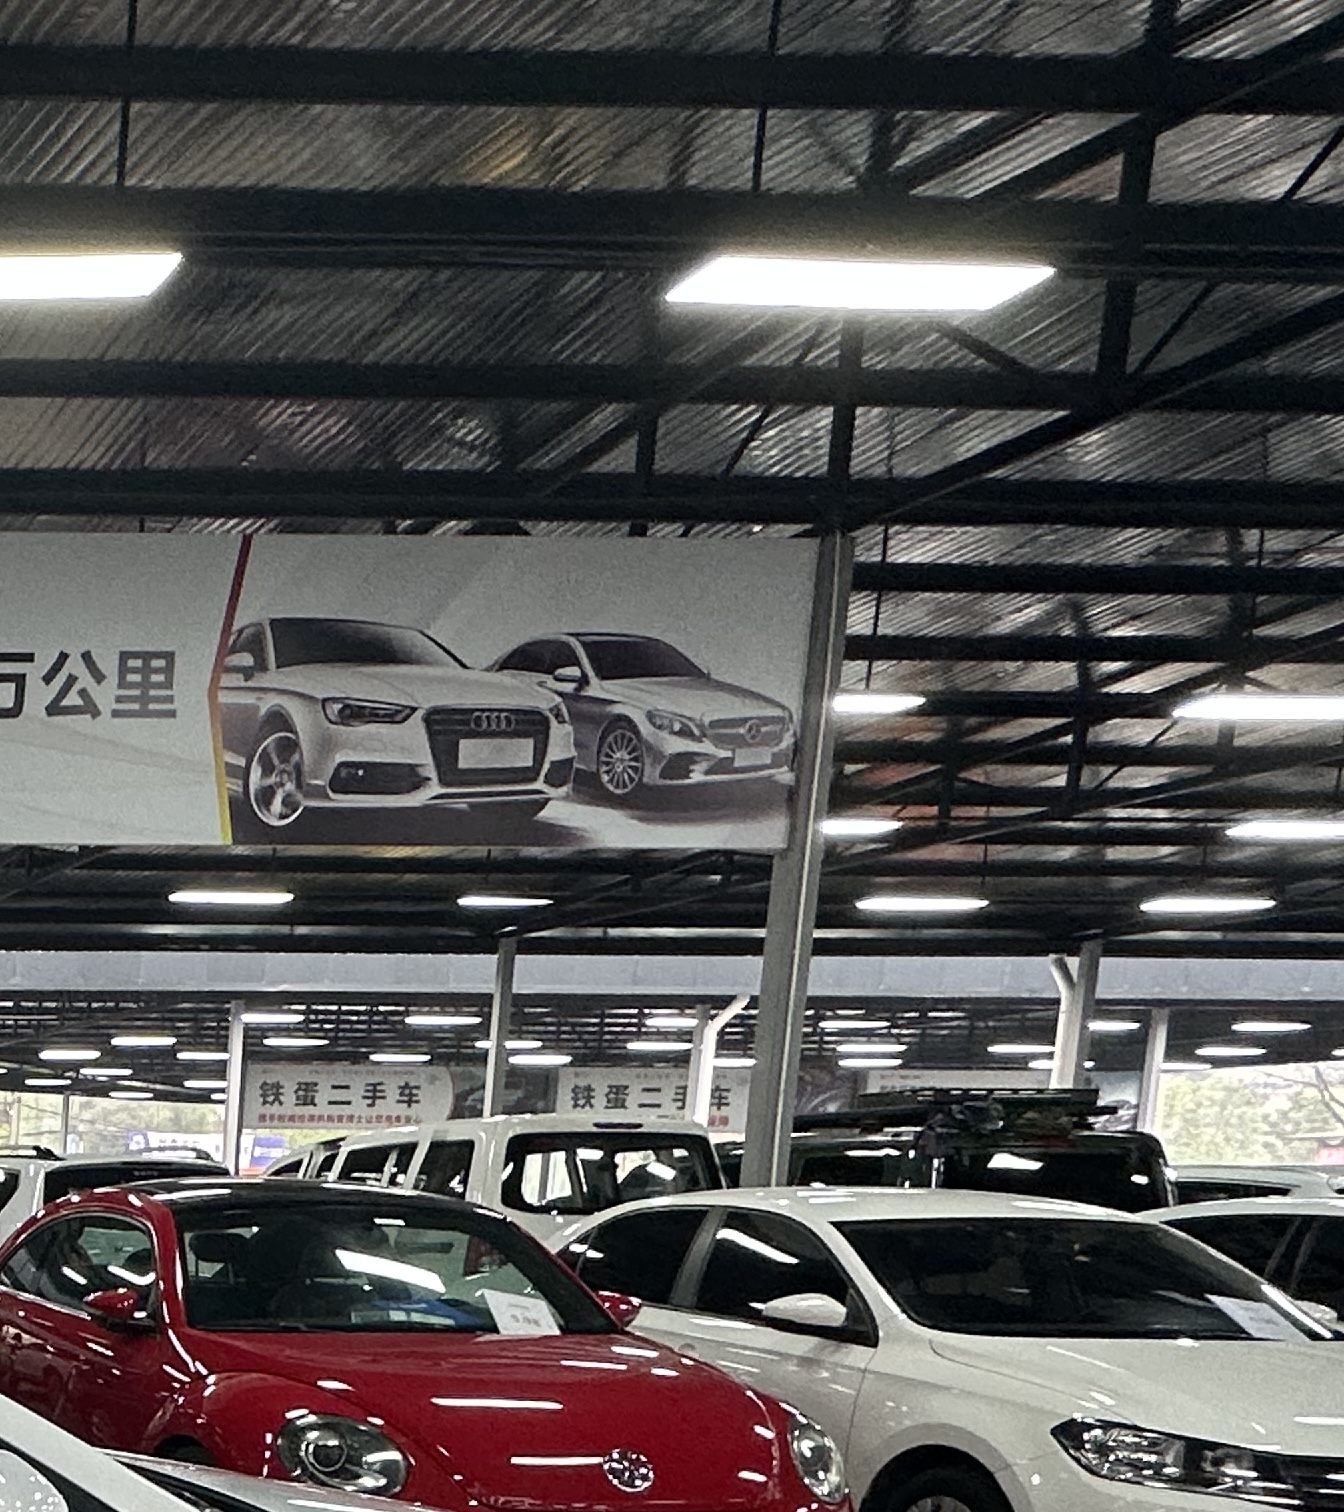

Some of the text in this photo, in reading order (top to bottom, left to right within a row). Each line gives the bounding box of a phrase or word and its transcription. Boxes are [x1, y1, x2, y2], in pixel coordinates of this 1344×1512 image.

[258, 1080, 422, 1108] 铁蛋二手车
